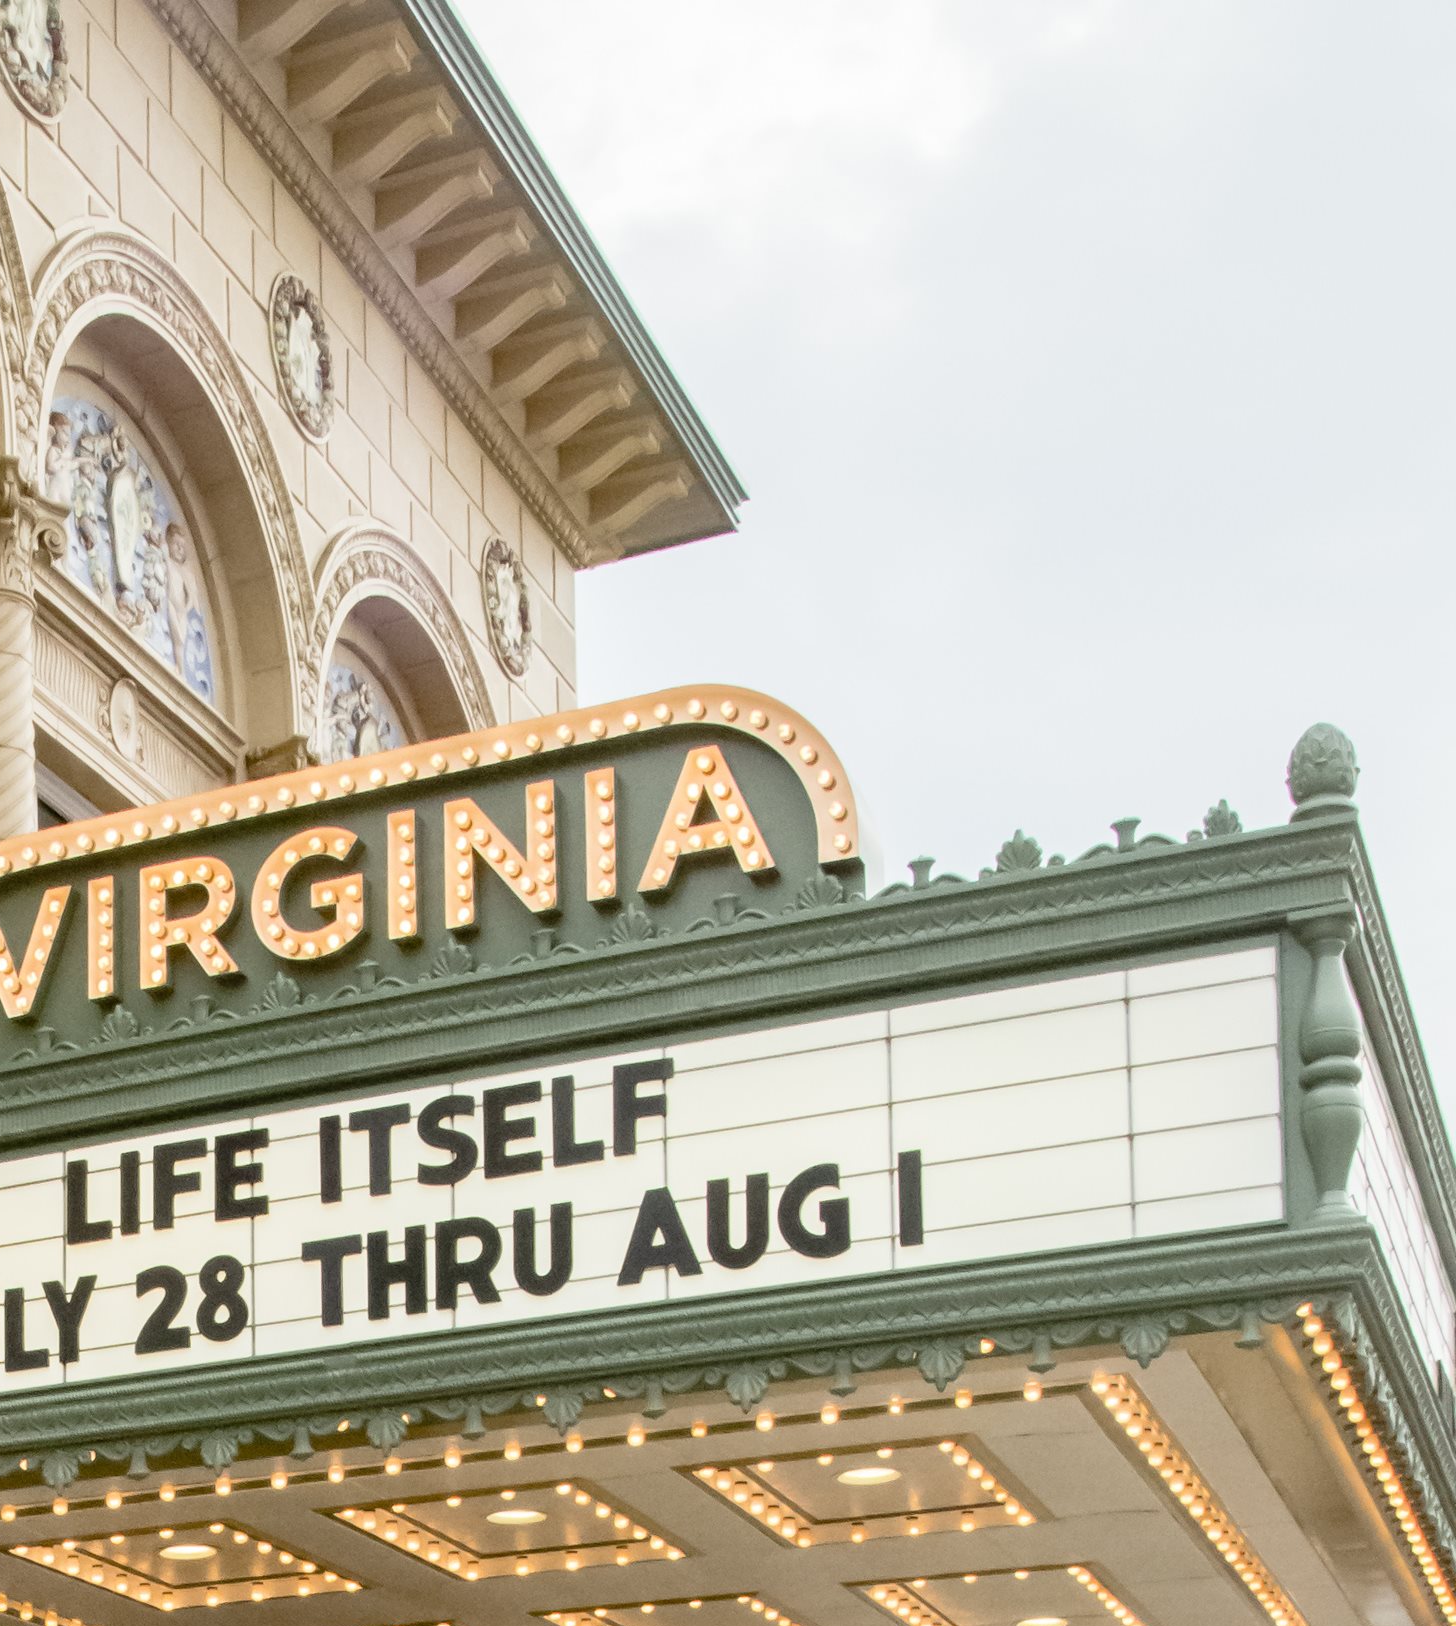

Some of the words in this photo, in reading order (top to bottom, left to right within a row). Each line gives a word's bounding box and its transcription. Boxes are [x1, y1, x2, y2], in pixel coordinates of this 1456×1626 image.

[65, 1127, 270, 1246] LIFE
[318, 1056, 675, 1203] ITSELF
[133, 1254, 249, 1355] 28
[300, 1201, 574, 1328] THRU
[615, 1161, 851, 1287] AUG
